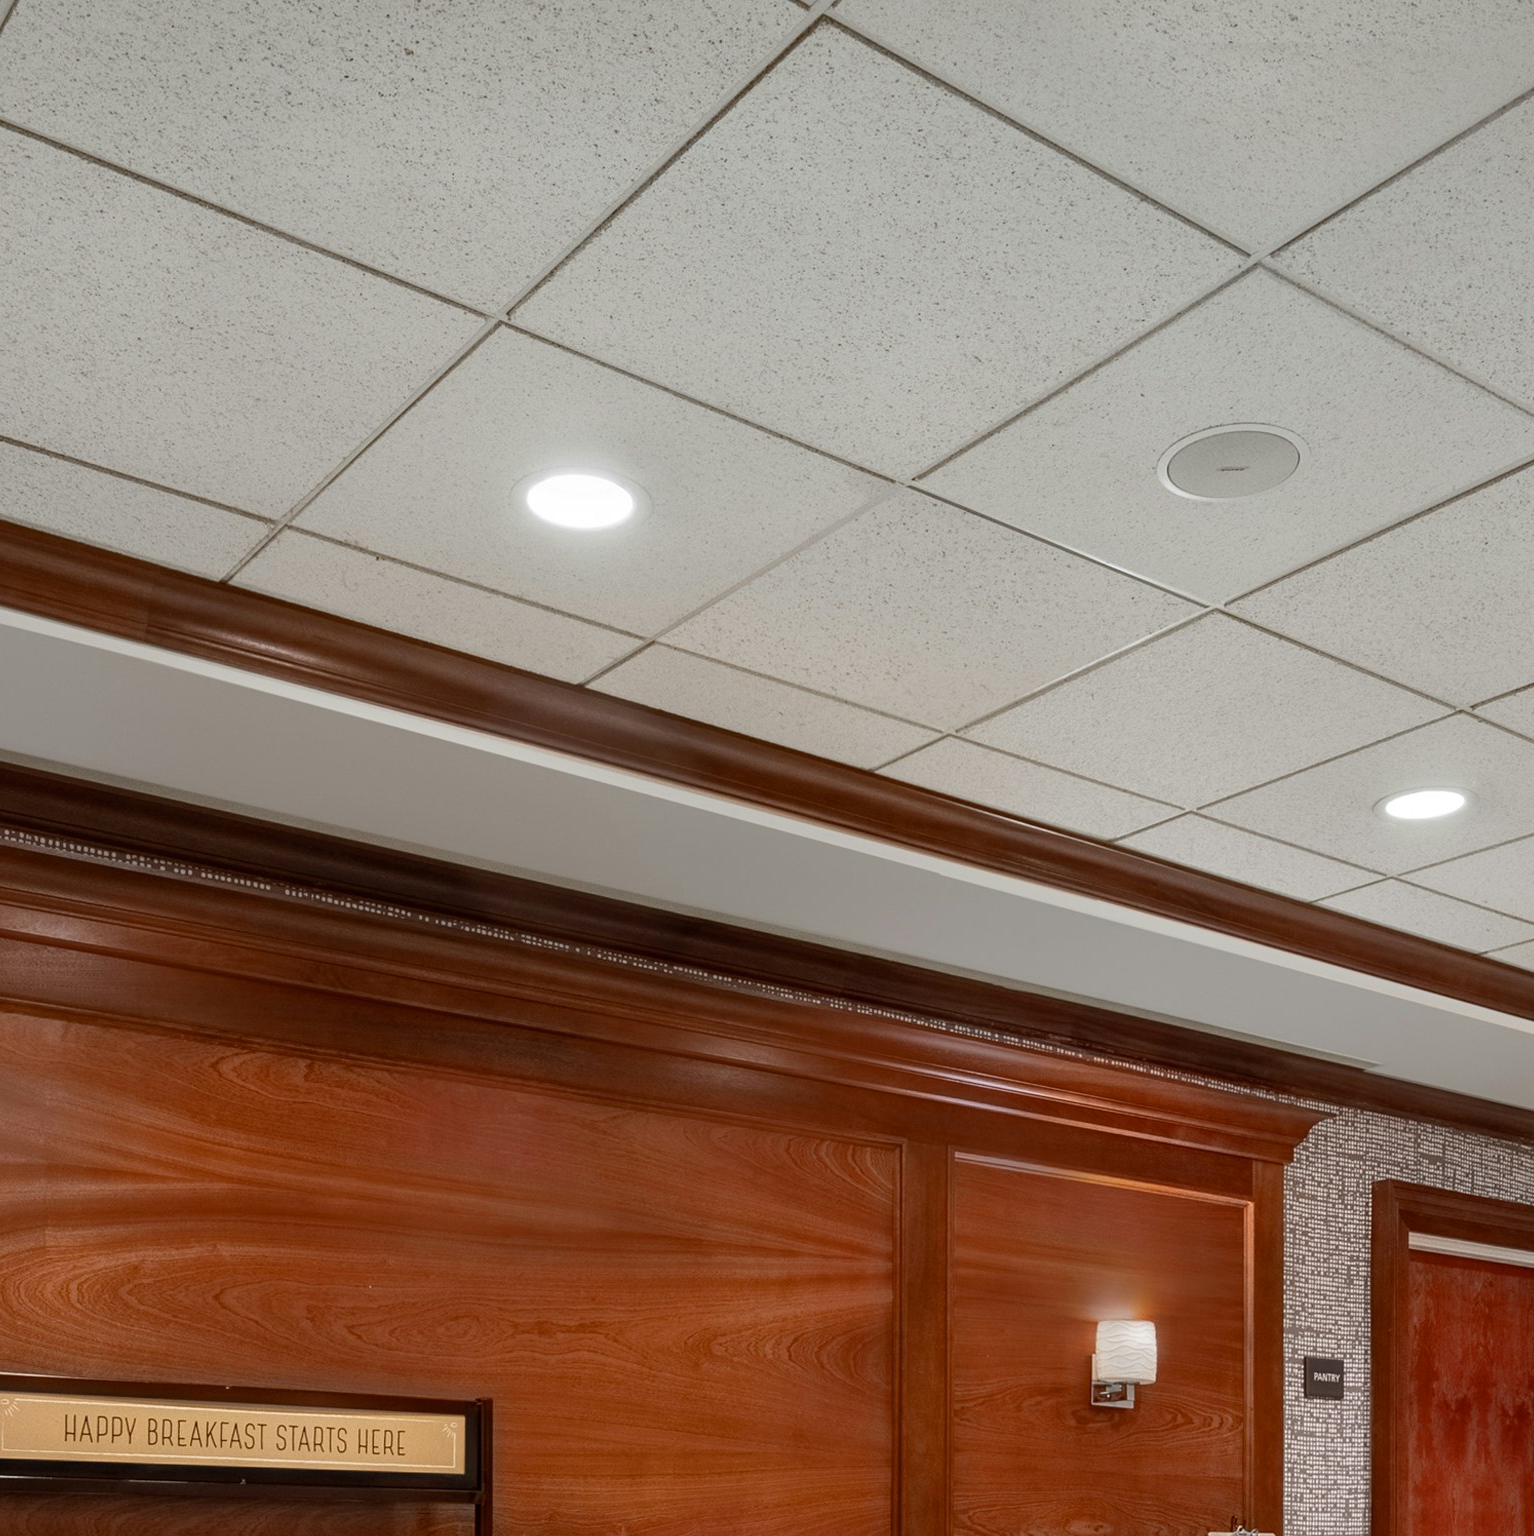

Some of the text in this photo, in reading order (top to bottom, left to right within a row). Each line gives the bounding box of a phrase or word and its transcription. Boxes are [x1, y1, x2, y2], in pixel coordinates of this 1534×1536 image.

[1313, 1371, 1341, 1383] PANTRY
[64, 1414, 406, 1456] HAPPY BREAKFAST STARTS HERE
